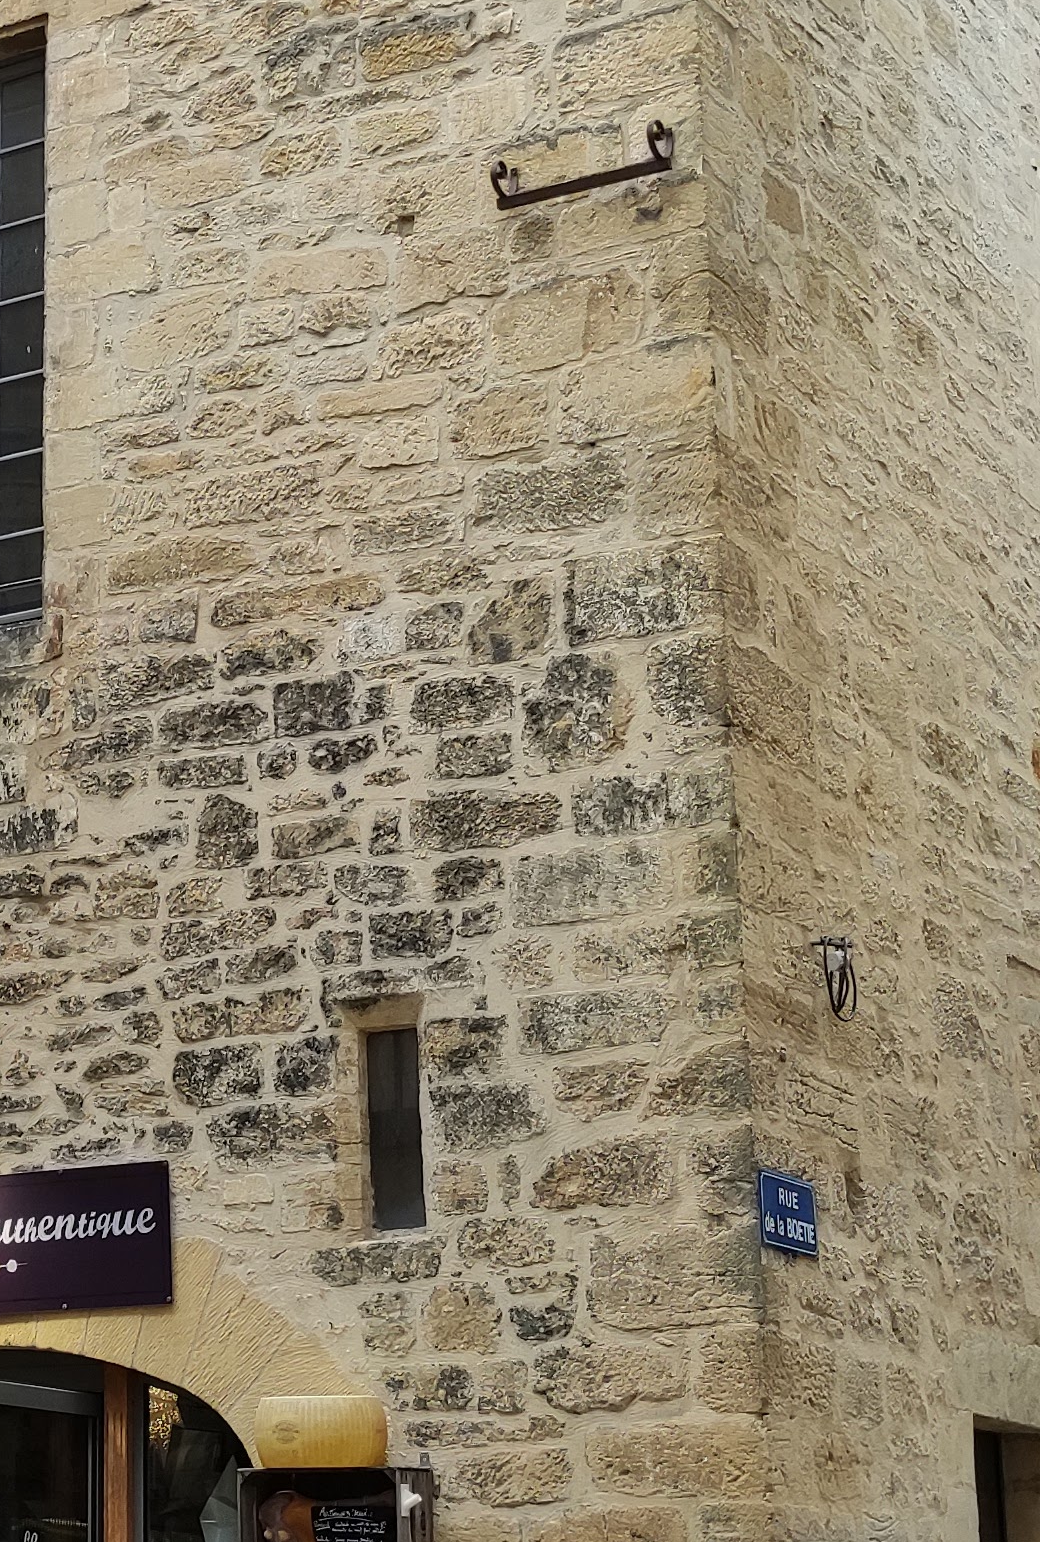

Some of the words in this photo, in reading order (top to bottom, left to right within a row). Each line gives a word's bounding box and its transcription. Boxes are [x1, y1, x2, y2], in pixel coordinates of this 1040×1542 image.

[778, 1187, 799, 1210] RUE
[765, 1211, 775, 1233] de
[777, 1215, 785, 1236] la
[787, 1218, 815, 1245] BOETIE
